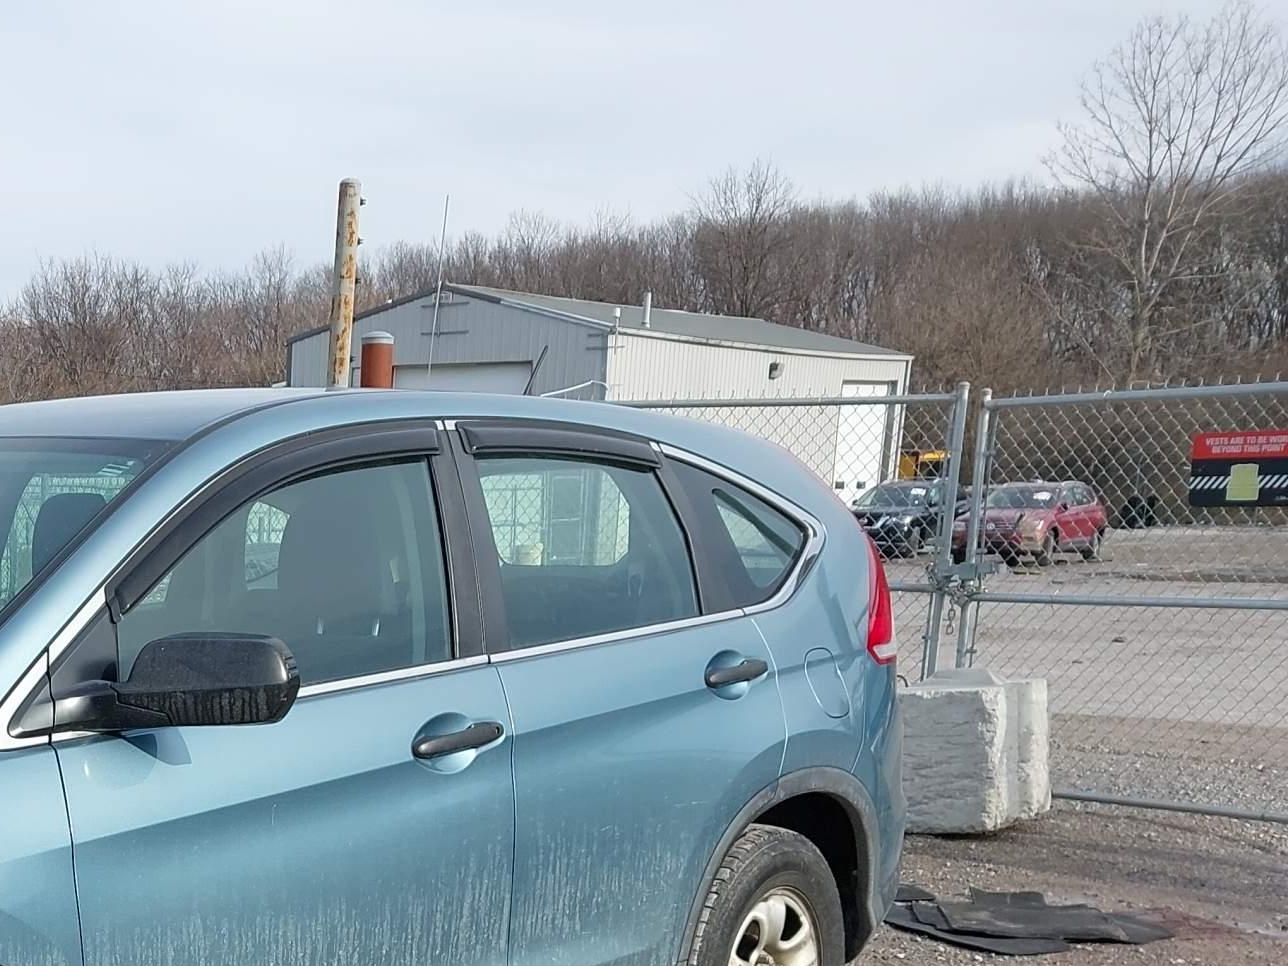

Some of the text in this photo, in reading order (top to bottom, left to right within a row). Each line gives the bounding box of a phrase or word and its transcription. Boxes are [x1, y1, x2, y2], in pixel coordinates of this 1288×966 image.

[1206, 437, 1229, 447] VESTS
[1230, 436, 1244, 445] ARE
[1246, 436, 1256, 444] TO
[1257, 435, 1267, 444] BE
[1212, 443, 1285, 454] BEYOND THIS POINT
